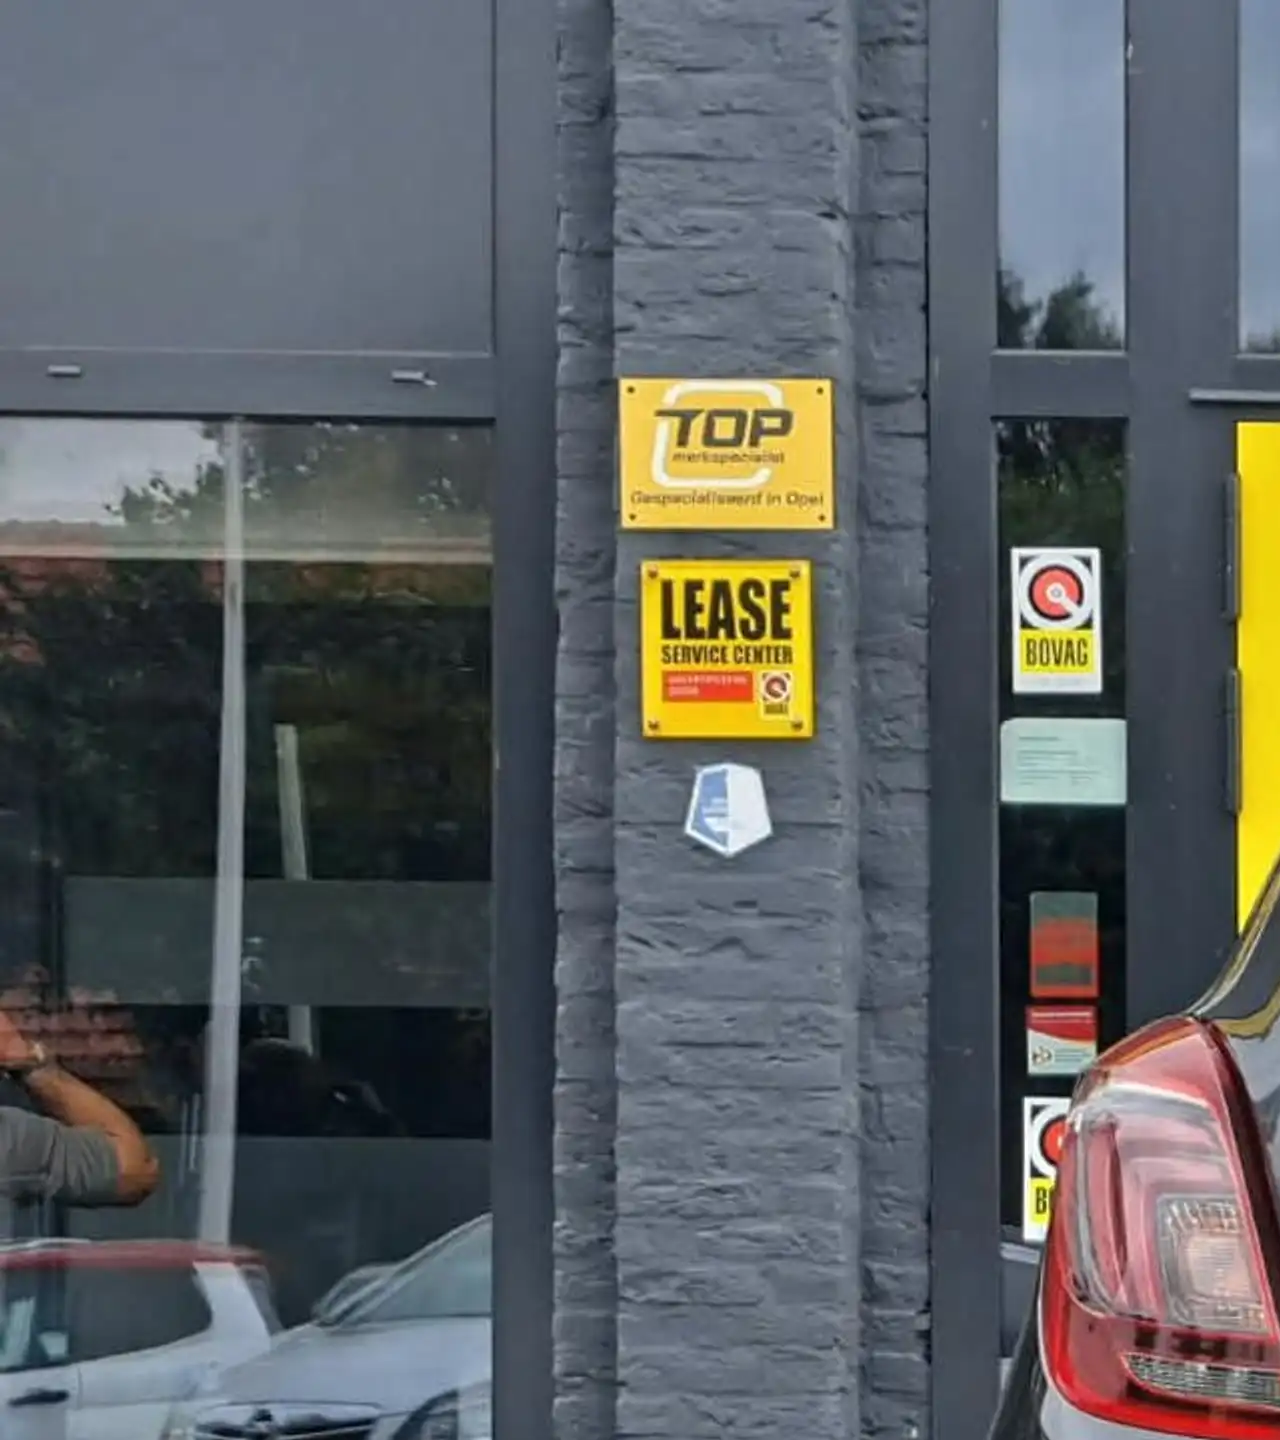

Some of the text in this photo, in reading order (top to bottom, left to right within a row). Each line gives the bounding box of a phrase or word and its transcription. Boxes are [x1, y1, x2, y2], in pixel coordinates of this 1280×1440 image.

[654, 407, 793, 447] TOP
[786, 490, 824, 507] Opel
[661, 578, 793, 642] LEASE
[661, 644, 793, 665] SERVICE CENTER
[1026, 637, 1088, 668] BOVAG
